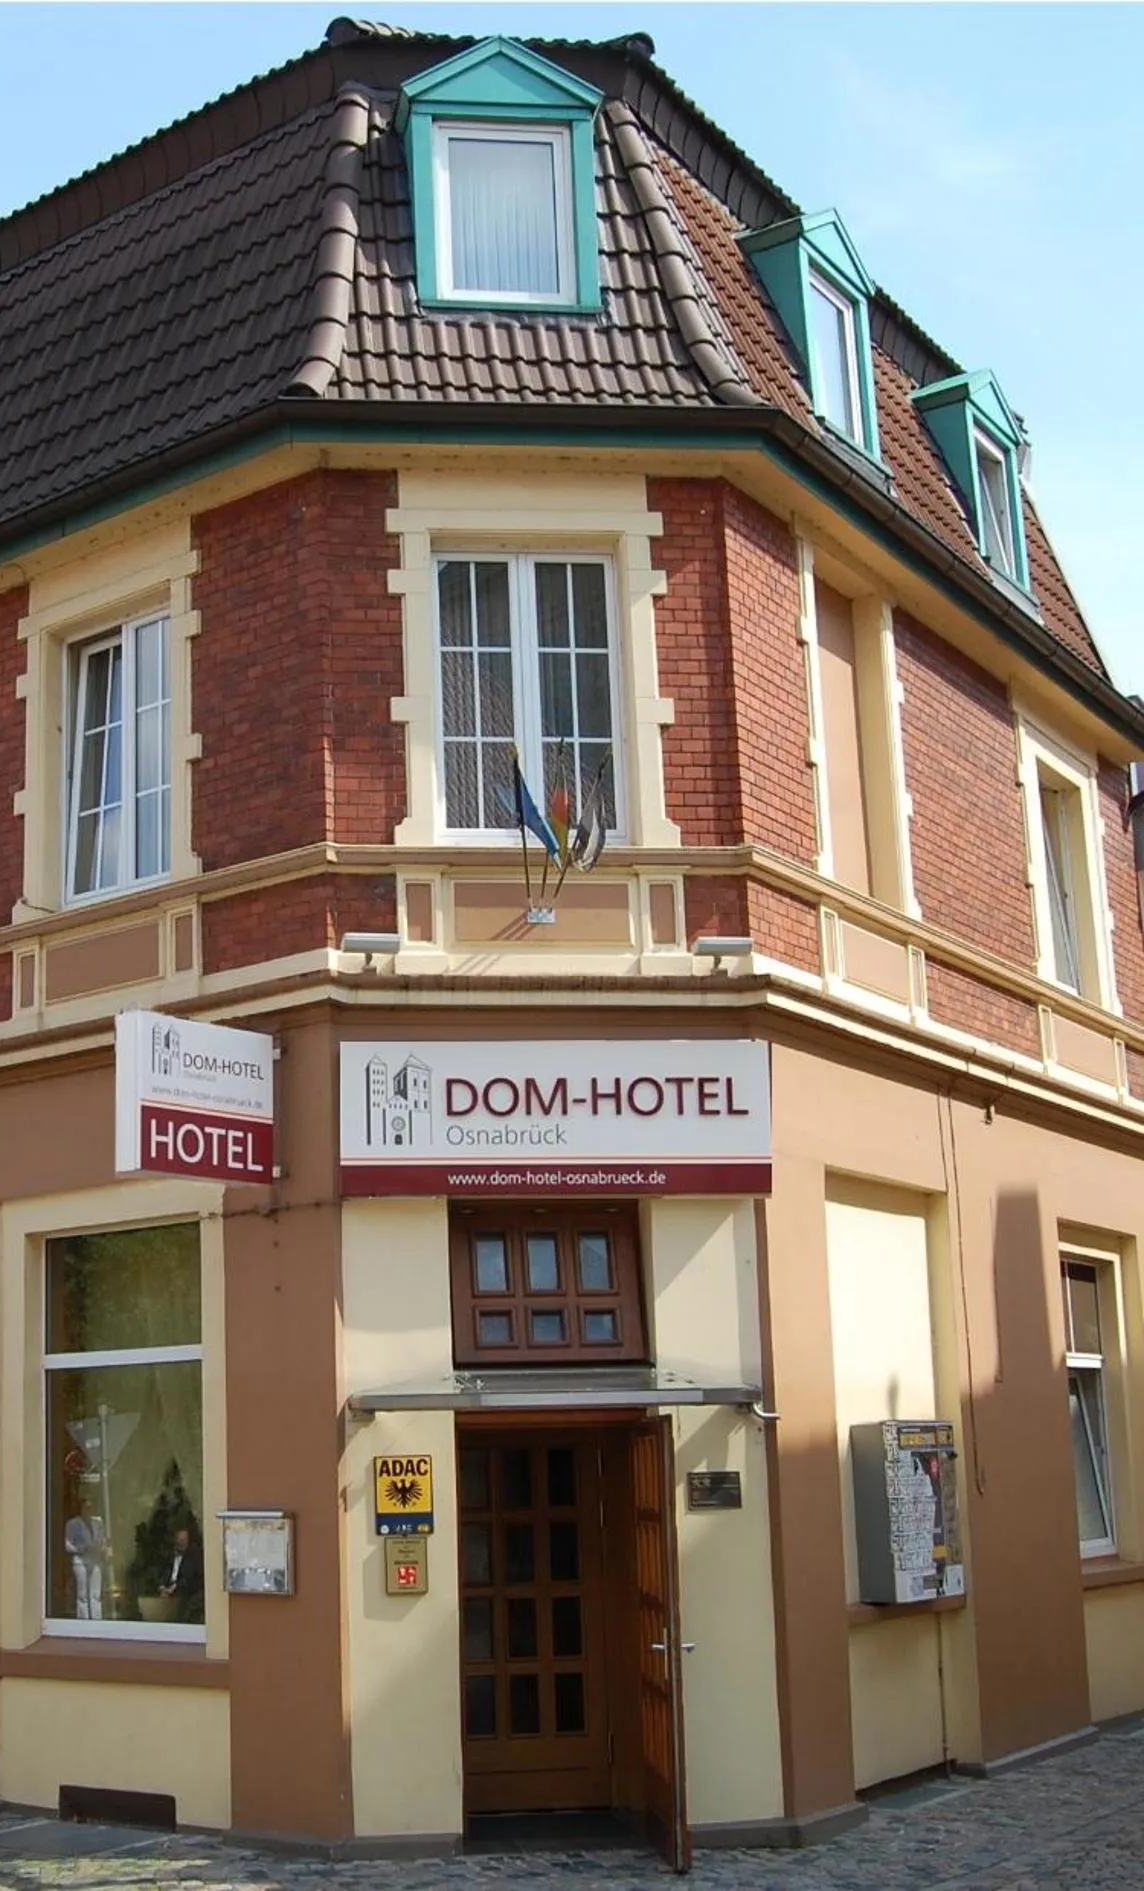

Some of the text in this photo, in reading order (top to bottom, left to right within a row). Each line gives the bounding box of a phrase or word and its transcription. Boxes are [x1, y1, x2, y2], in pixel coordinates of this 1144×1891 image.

[183, 1052, 264, 1081] DOM-HOTEL
[445, 1076, 749, 1117] DOM-HOTEL
[150, 1118, 264, 1172] HOTEL
[445, 1123, 567, 1146] Osnabrück
[447, 1170, 667, 1187] www.dom-hotel-osnabrueck.de
[379, 1458, 429, 1477] ADAC
